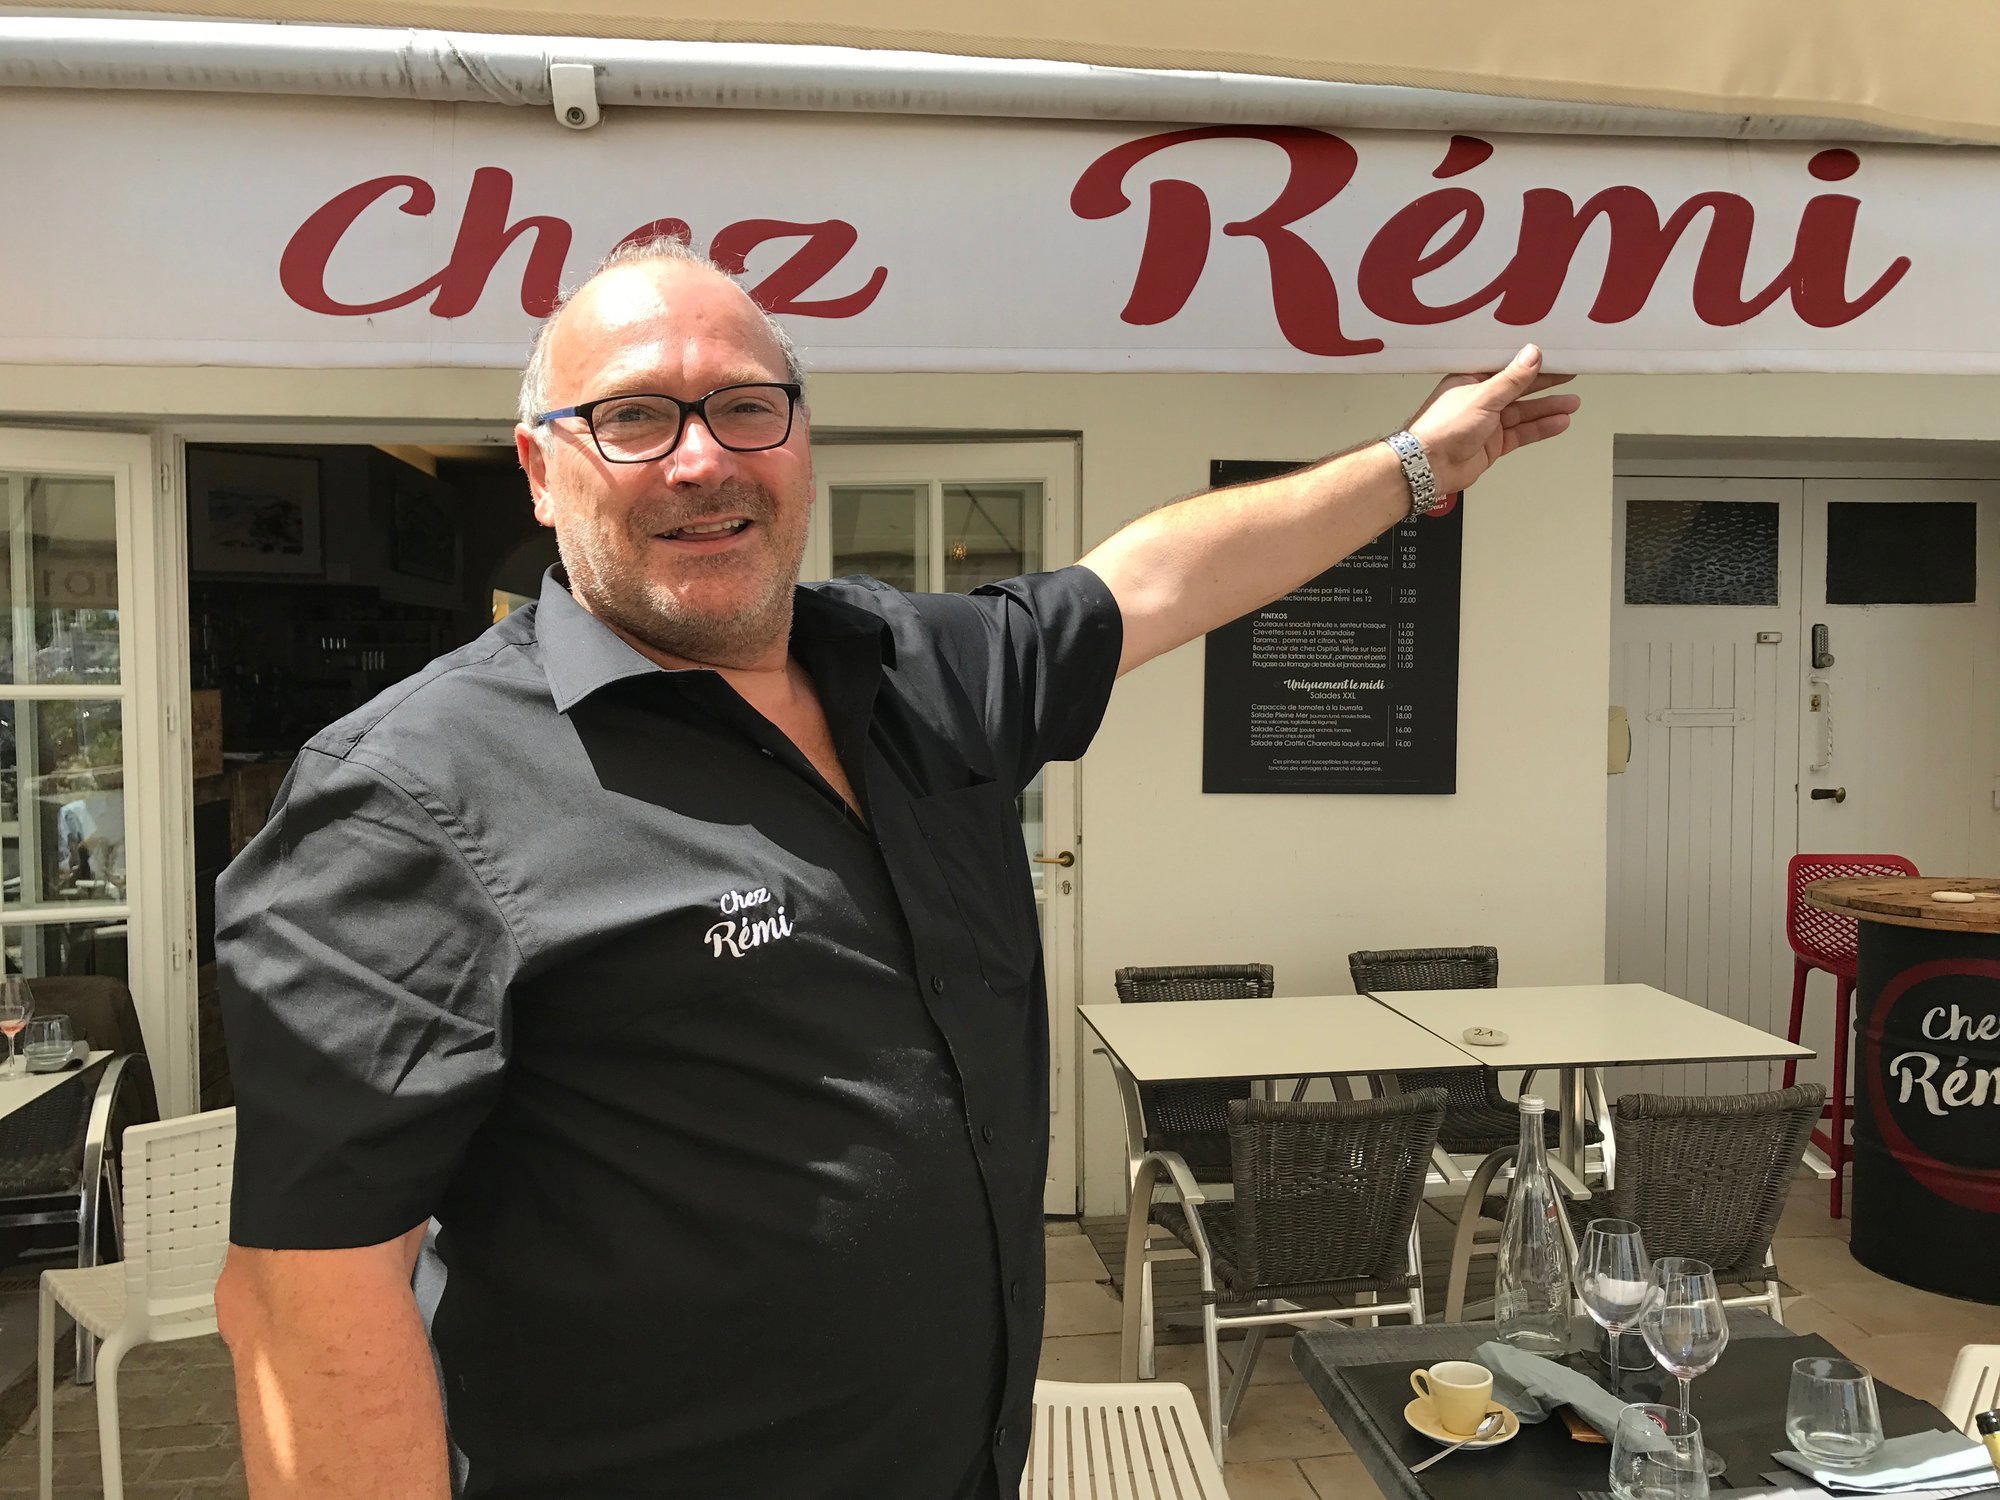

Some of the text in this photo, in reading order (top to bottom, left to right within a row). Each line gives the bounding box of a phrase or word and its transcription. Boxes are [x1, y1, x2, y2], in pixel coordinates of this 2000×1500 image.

[1070, 125, 1911, 356] Rémi
[1321, 587, 1332, 595] par
[1321, 595, 1332, 603] par
[1353, 595, 1363, 603] Les
[1365, 595, 1373, 603] 12
[1283, 679, 1385, 691] Uniquement le midi
[721, 888, 771, 914] Chez
[704, 906, 793, 957] Rémi
[1922, 1004, 2000, 1041] Che
[1474, 1028, 1493, 1037] 21
